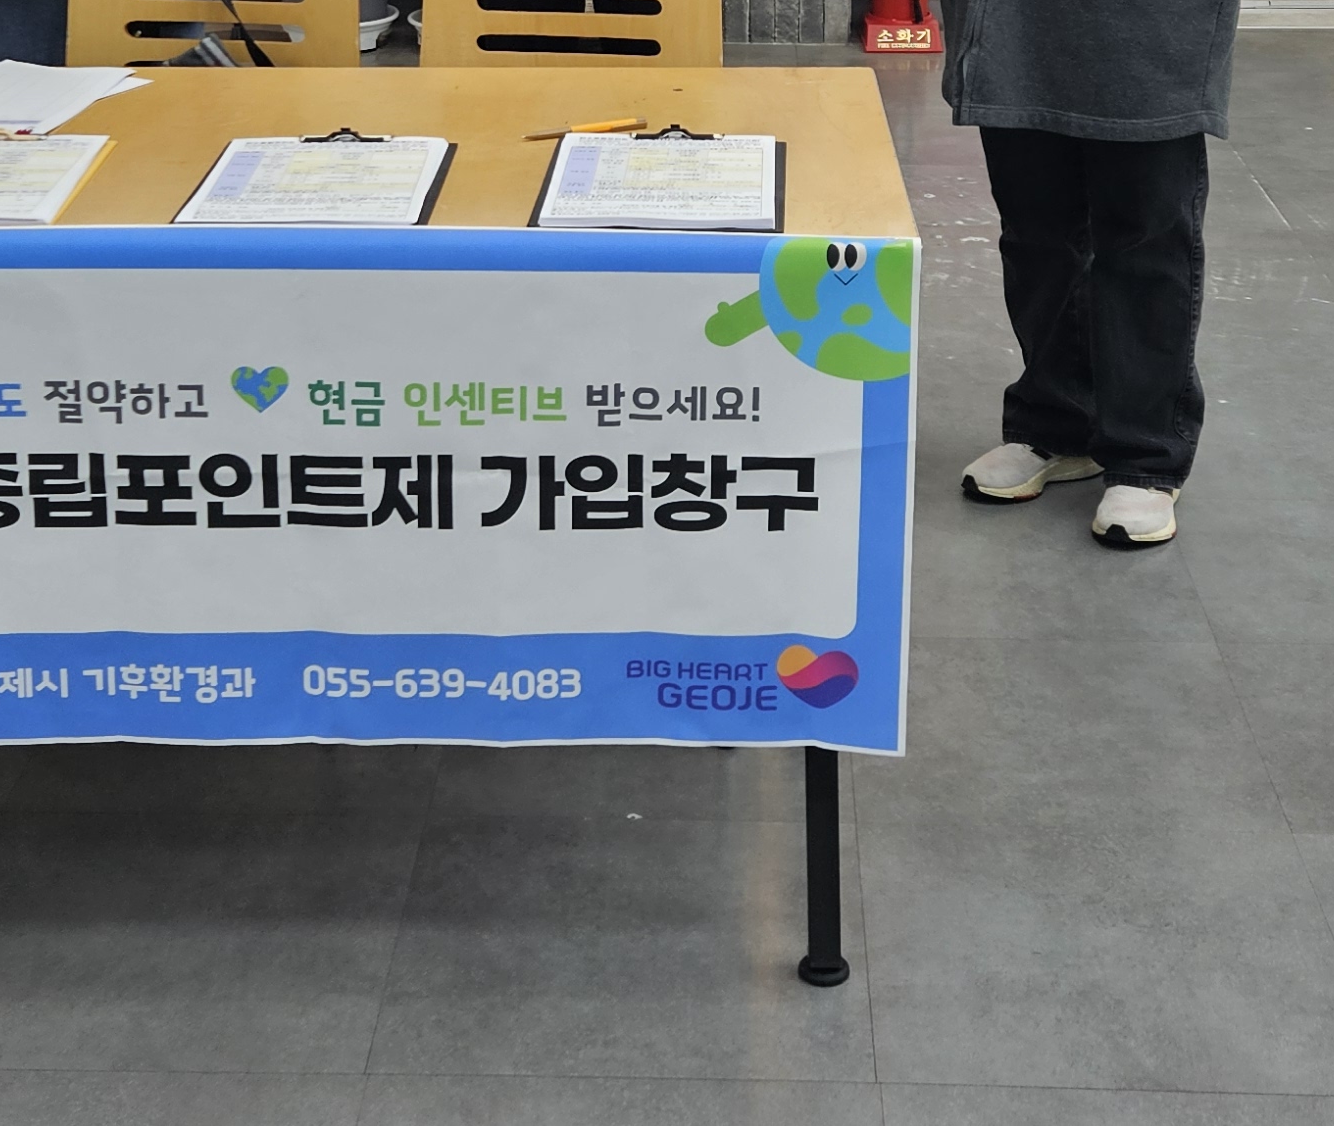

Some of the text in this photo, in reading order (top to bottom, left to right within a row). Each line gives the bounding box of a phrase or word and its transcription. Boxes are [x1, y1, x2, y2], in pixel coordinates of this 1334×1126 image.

[876, 28, 932, 44] 소화기
[43, 379, 210, 425] 절약하고
[307, 379, 386, 427] 현금
[402, 381, 568, 427] 인센티브
[584, 382, 762, 427] 받으세요!
[479, 452, 820, 532] 가입창구
[81, 663, 256, 705] 기후환경과
[301, 663, 583, 702] 055-639-4083
[624, 658, 769, 682] BIG HEART
[656, 682, 779, 712] GEOJE
